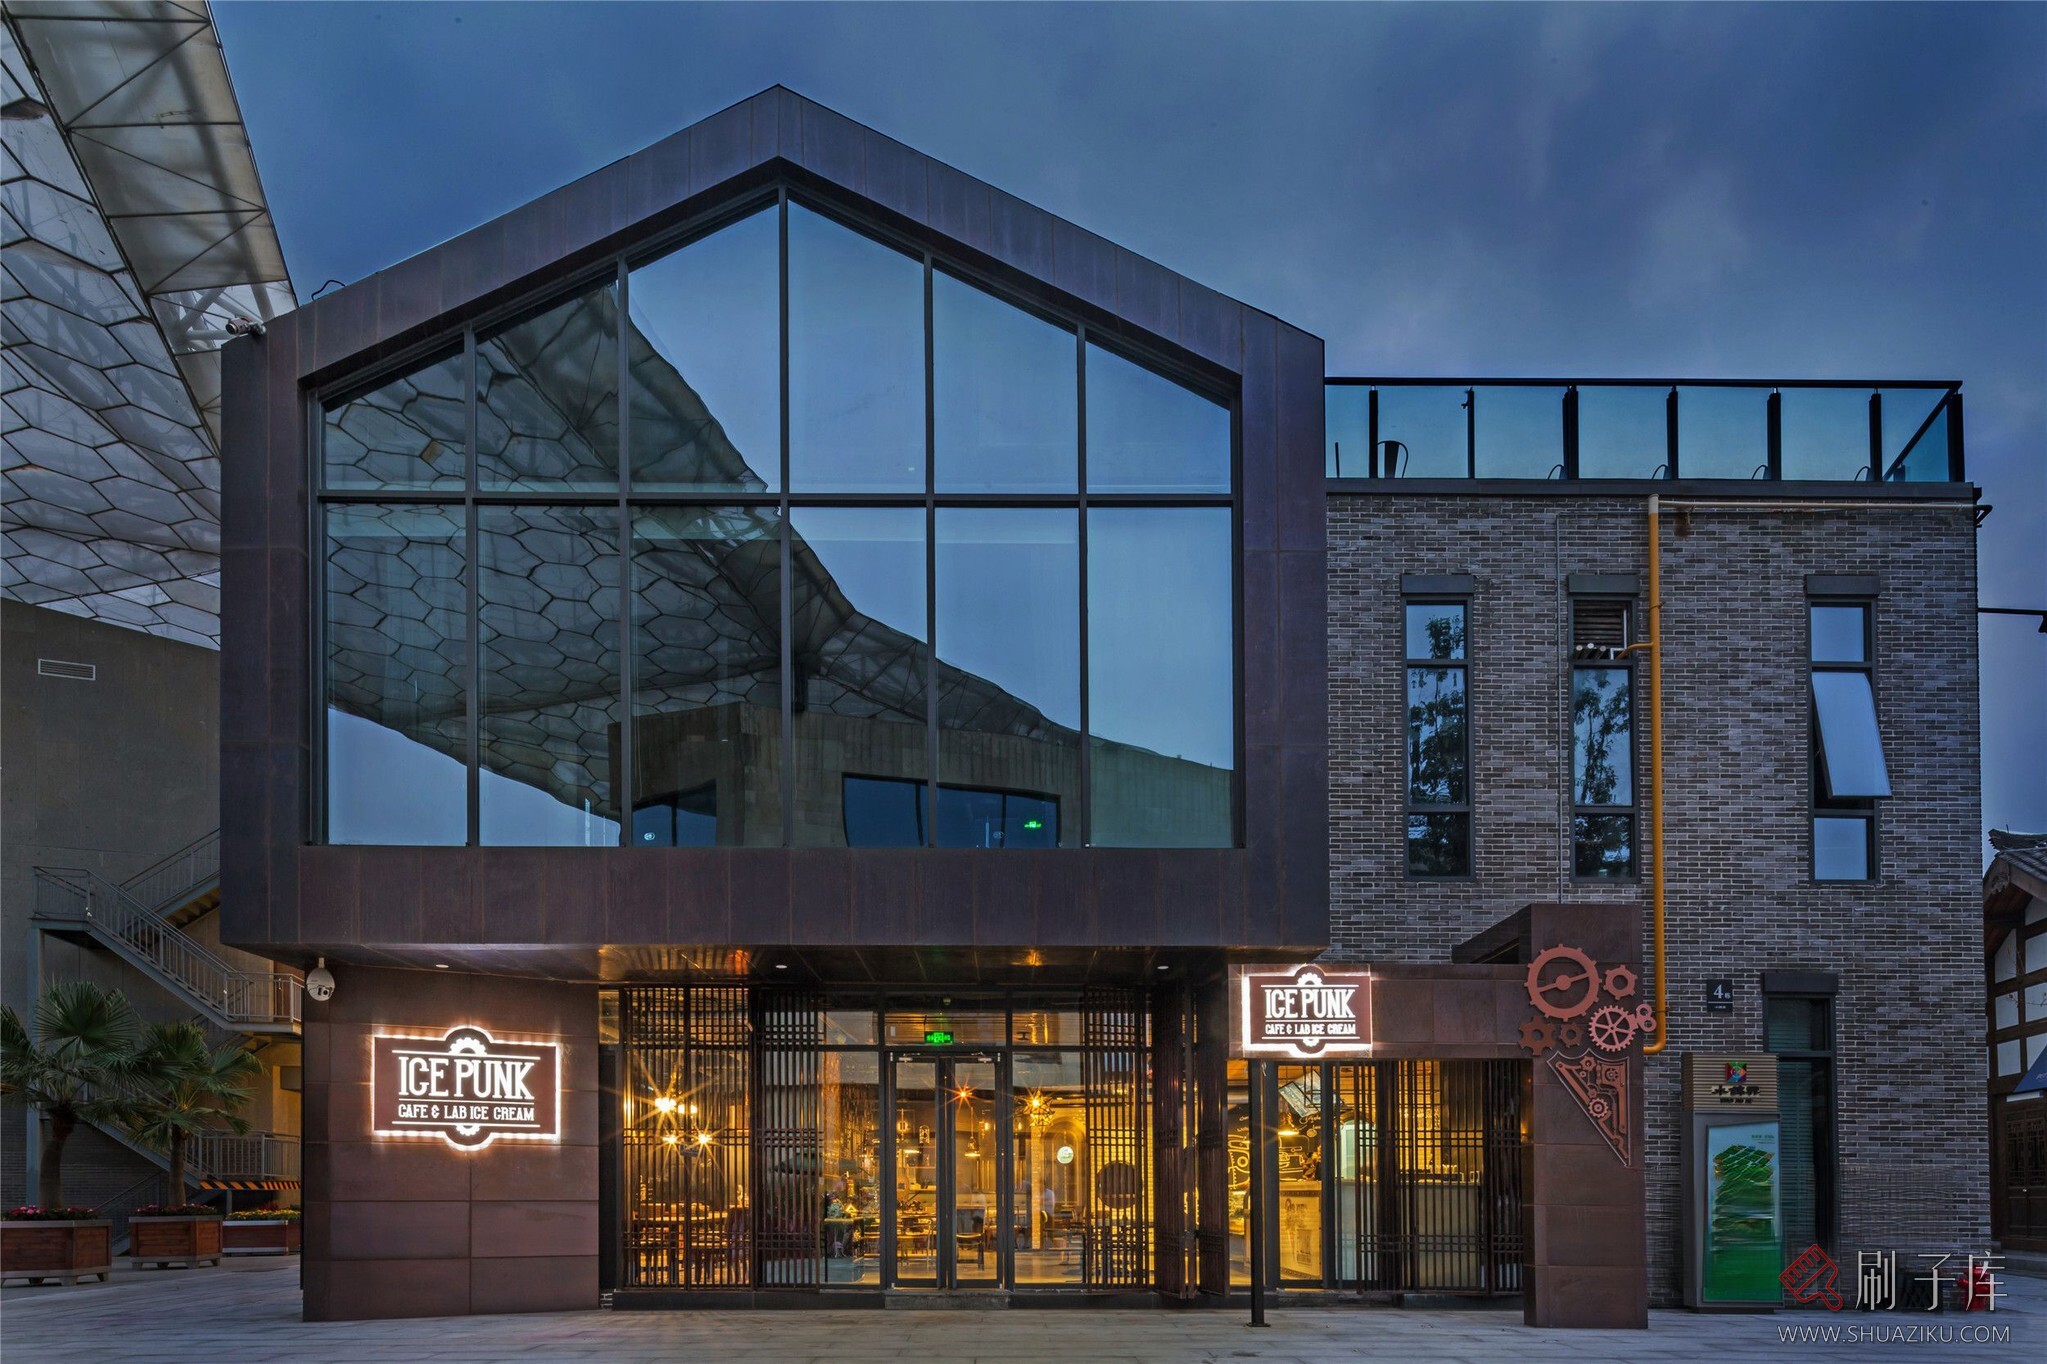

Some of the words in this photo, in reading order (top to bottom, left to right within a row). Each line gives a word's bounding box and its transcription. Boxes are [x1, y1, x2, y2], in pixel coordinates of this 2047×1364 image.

[1264, 989, 1298, 1019] ICE
[1301, 989, 1356, 1019] PUNK
[1265, 1024, 1285, 1035] CAFE
[1295, 1024, 1311, 1035] LAB
[1311, 1024, 1325, 1035] ICE
[1327, 1024, 1356, 1035] CREAM
[398, 1056, 449, 1097] ICE
[454, 1059, 535, 1100] PUNK
[398, 1104, 429, 1119] CAFE
[431, 1106, 440, 1119] &
[444, 1105, 467, 1120] LAB
[470, 1106, 489, 1120] ICE
[493, 1107, 535, 1122] CREAM
